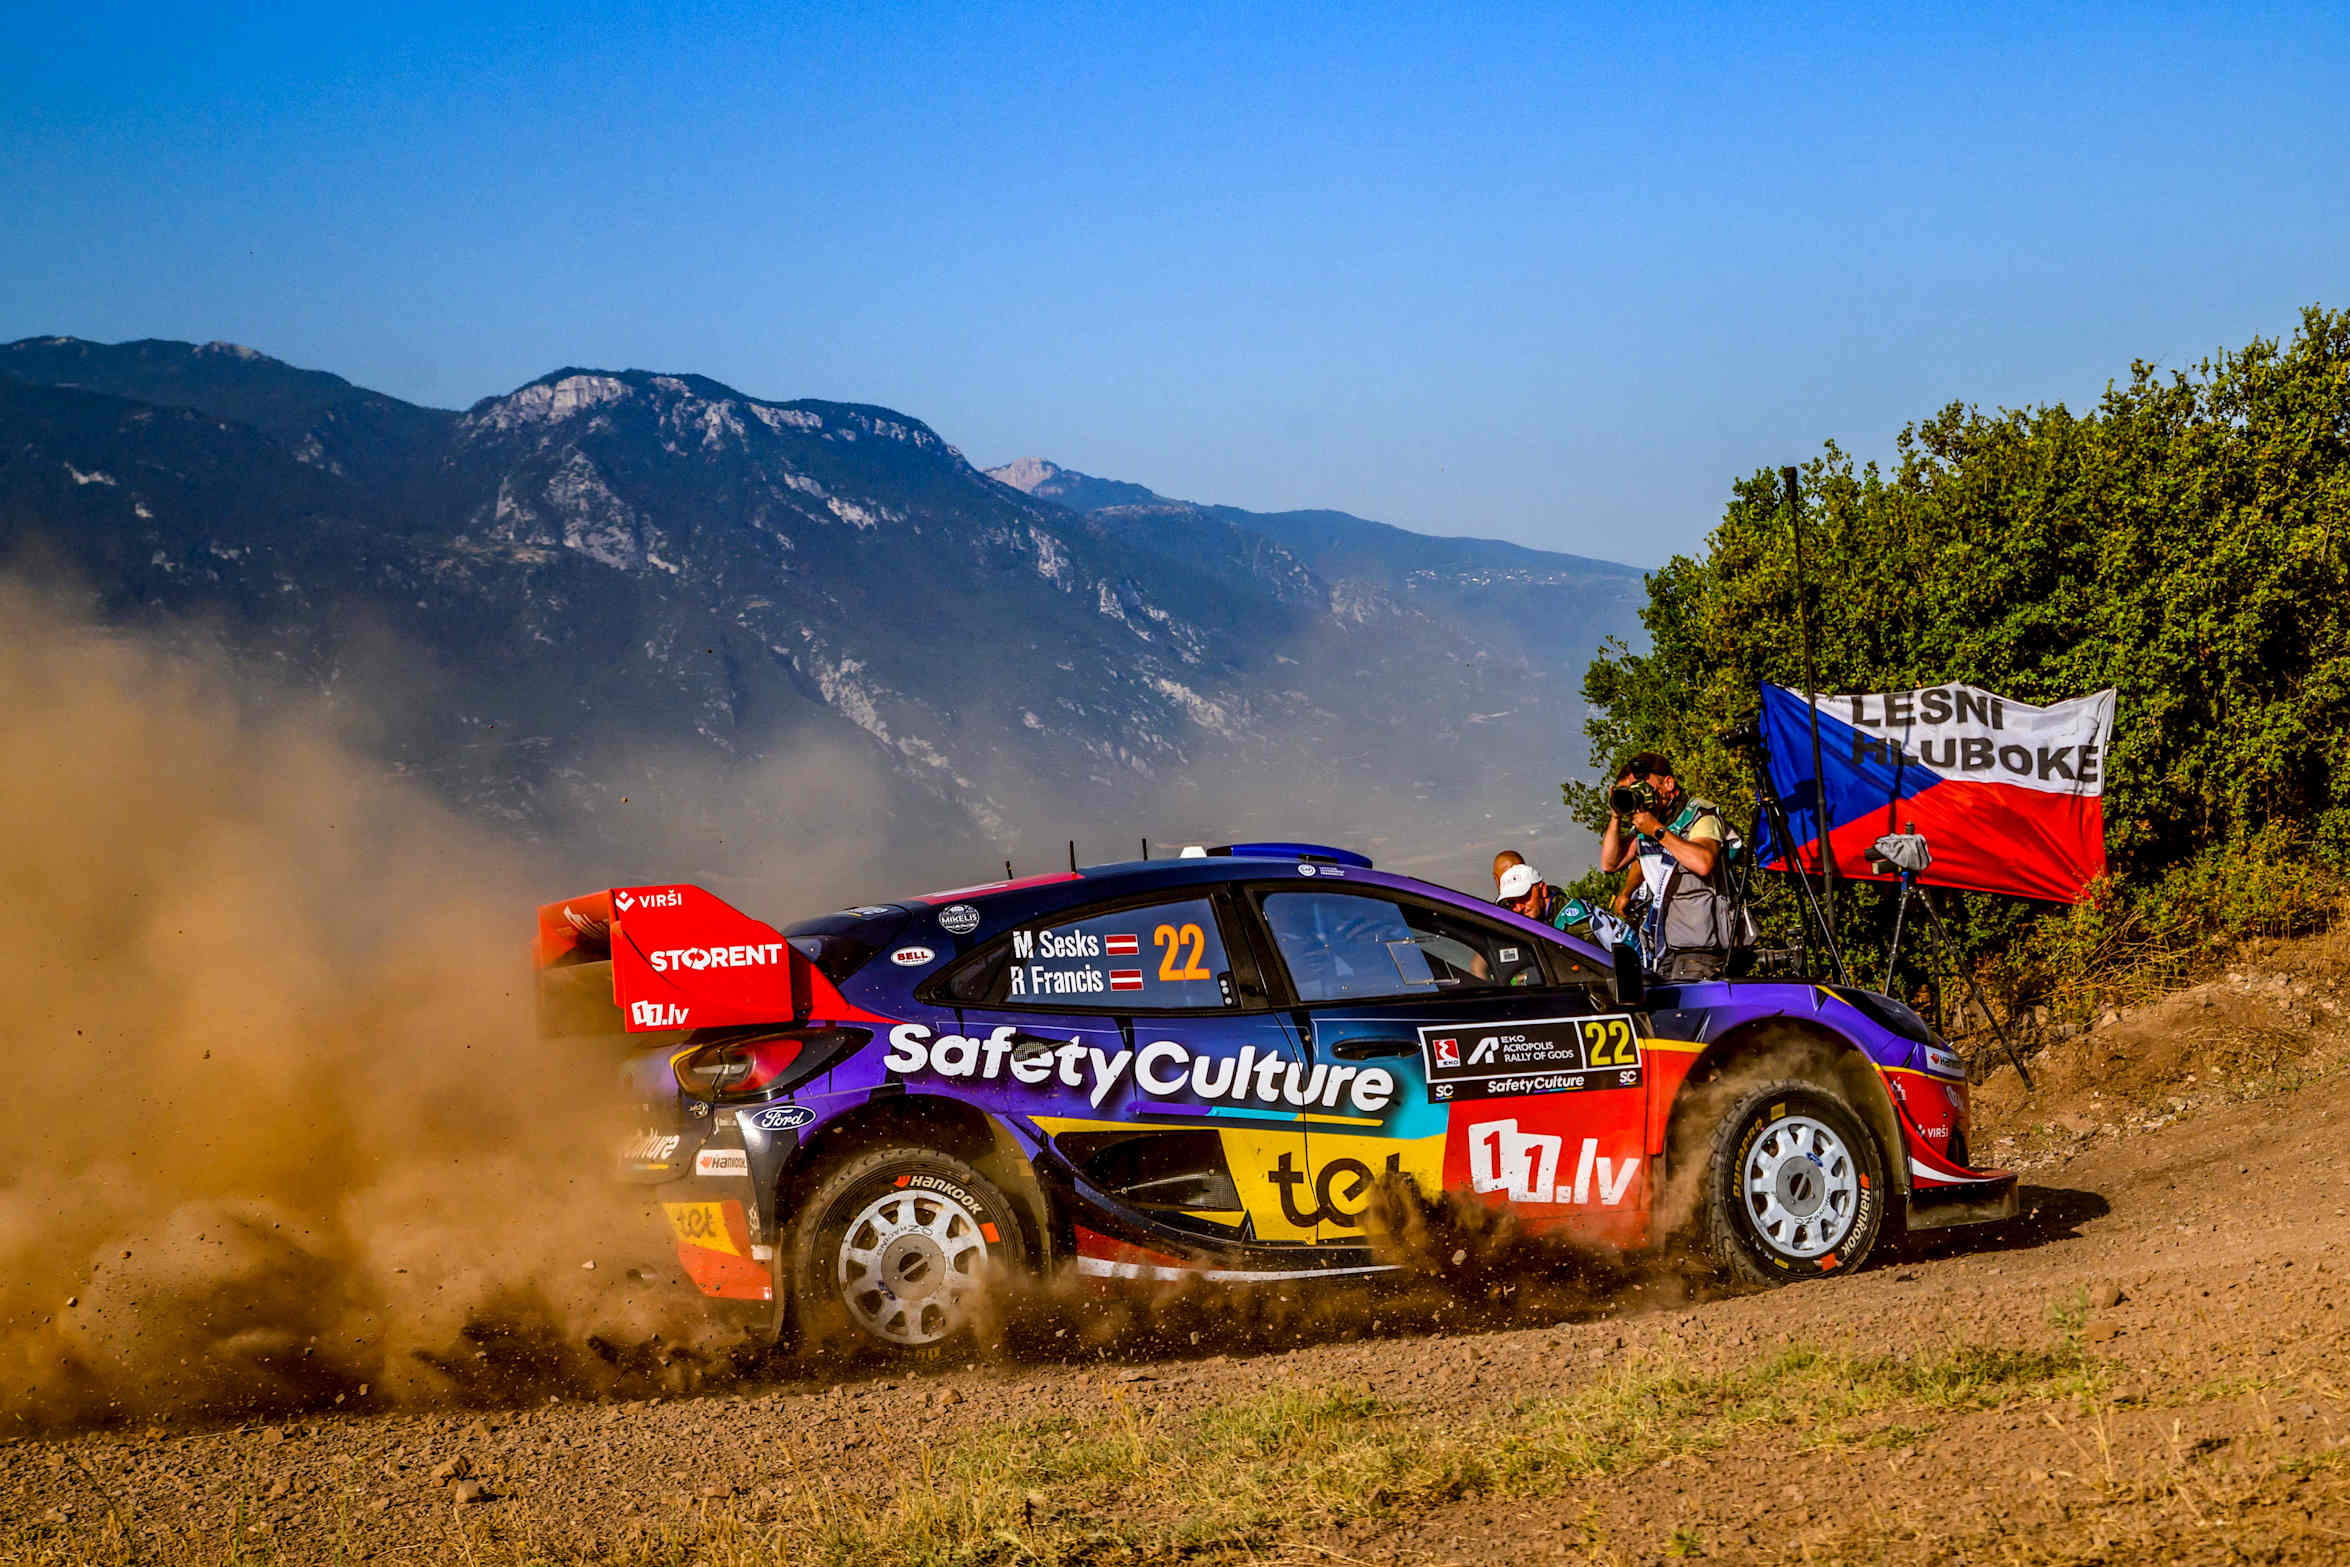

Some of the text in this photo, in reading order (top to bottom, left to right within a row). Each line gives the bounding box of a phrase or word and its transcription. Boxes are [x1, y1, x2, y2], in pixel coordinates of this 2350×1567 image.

[1851, 689, 2004, 730] LESNI
[1851, 731, 2099, 783] HLUBOKE
[639, 889, 682, 908] VIRŠI
[897, 951, 929, 961] BELL
[1013, 929, 1100, 959] M Sesks
[1153, 923, 1211, 982] 22
[650, 943, 783, 973] STORENT
[1010, 964, 1104, 995] R Francis
[1500, 1035, 1525, 1044] EKO
[1503, 1041, 1554, 1053] ACROPOLIS
[1585, 1020, 1635, 1066] 22
[884, 1023, 1395, 1112] SafetyCulture
[1504, 1049, 1575, 1063] RALLY OF GODS
[1488, 1076, 1585, 1094] SafetyCulture
[1619, 1071, 1637, 1084] SC
[1435, 1084, 1454, 1097] SC
[761, 1109, 805, 1128] Ford
[1468, 1118, 1641, 1206] 11.lv
